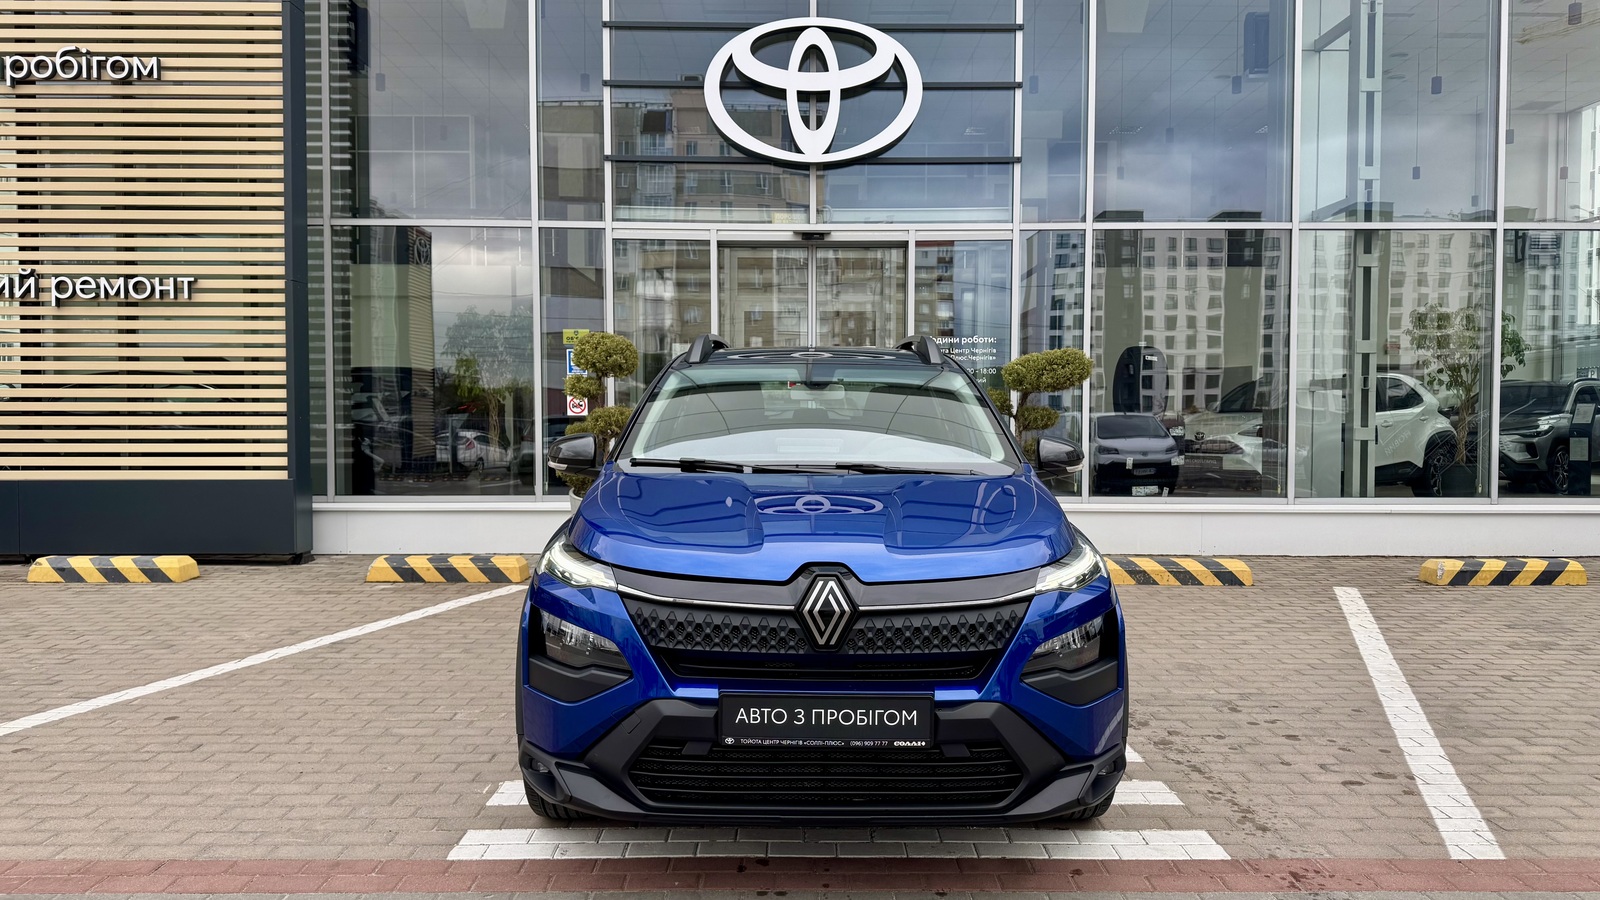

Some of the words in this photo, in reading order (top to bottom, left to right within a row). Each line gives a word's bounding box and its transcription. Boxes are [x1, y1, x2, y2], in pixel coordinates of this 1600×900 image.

[5, 46, 160, 88] робігом
[51, 276, 196, 308] ремонт
[961, 335, 997, 345] роботи:
[735, 708, 788, 725] АВТО
[793, 709, 805, 725] З
[812, 709, 918, 726] ПРОБІГОМ
